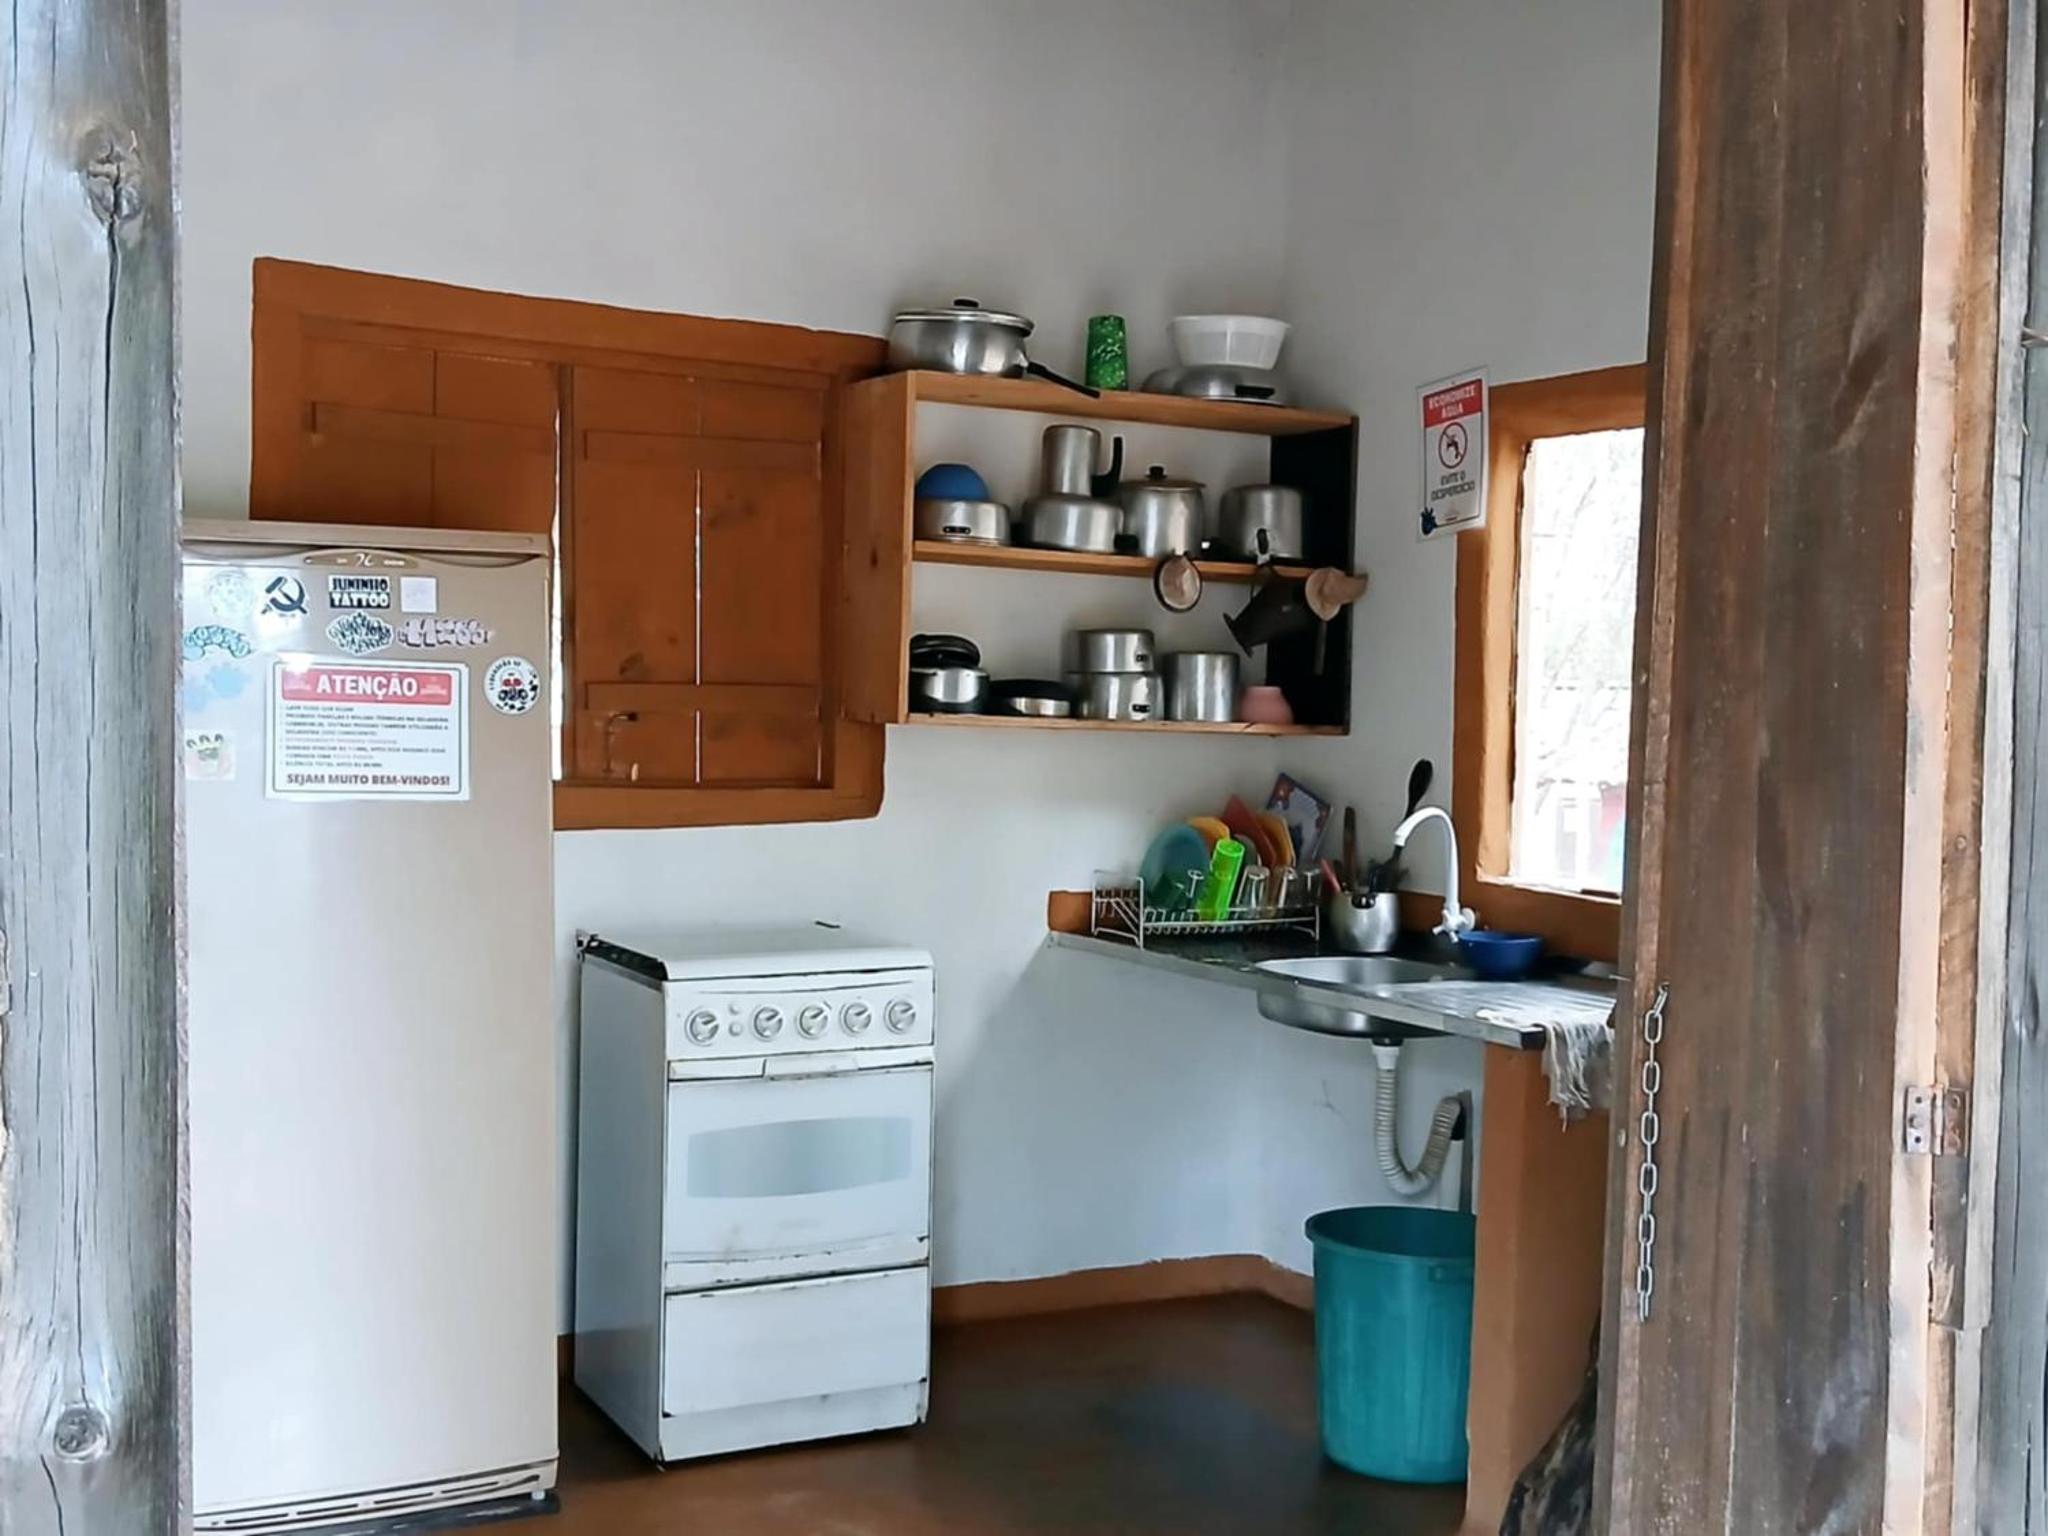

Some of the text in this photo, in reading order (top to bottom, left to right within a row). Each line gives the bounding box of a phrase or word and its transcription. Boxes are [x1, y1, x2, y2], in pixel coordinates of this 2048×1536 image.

[331, 593, 389, 607] TATTOO
[316, 673, 418, 700] ATENÇÃO
[287, 774, 451, 786] SEJAM MUITO BEM-VINDOS!
